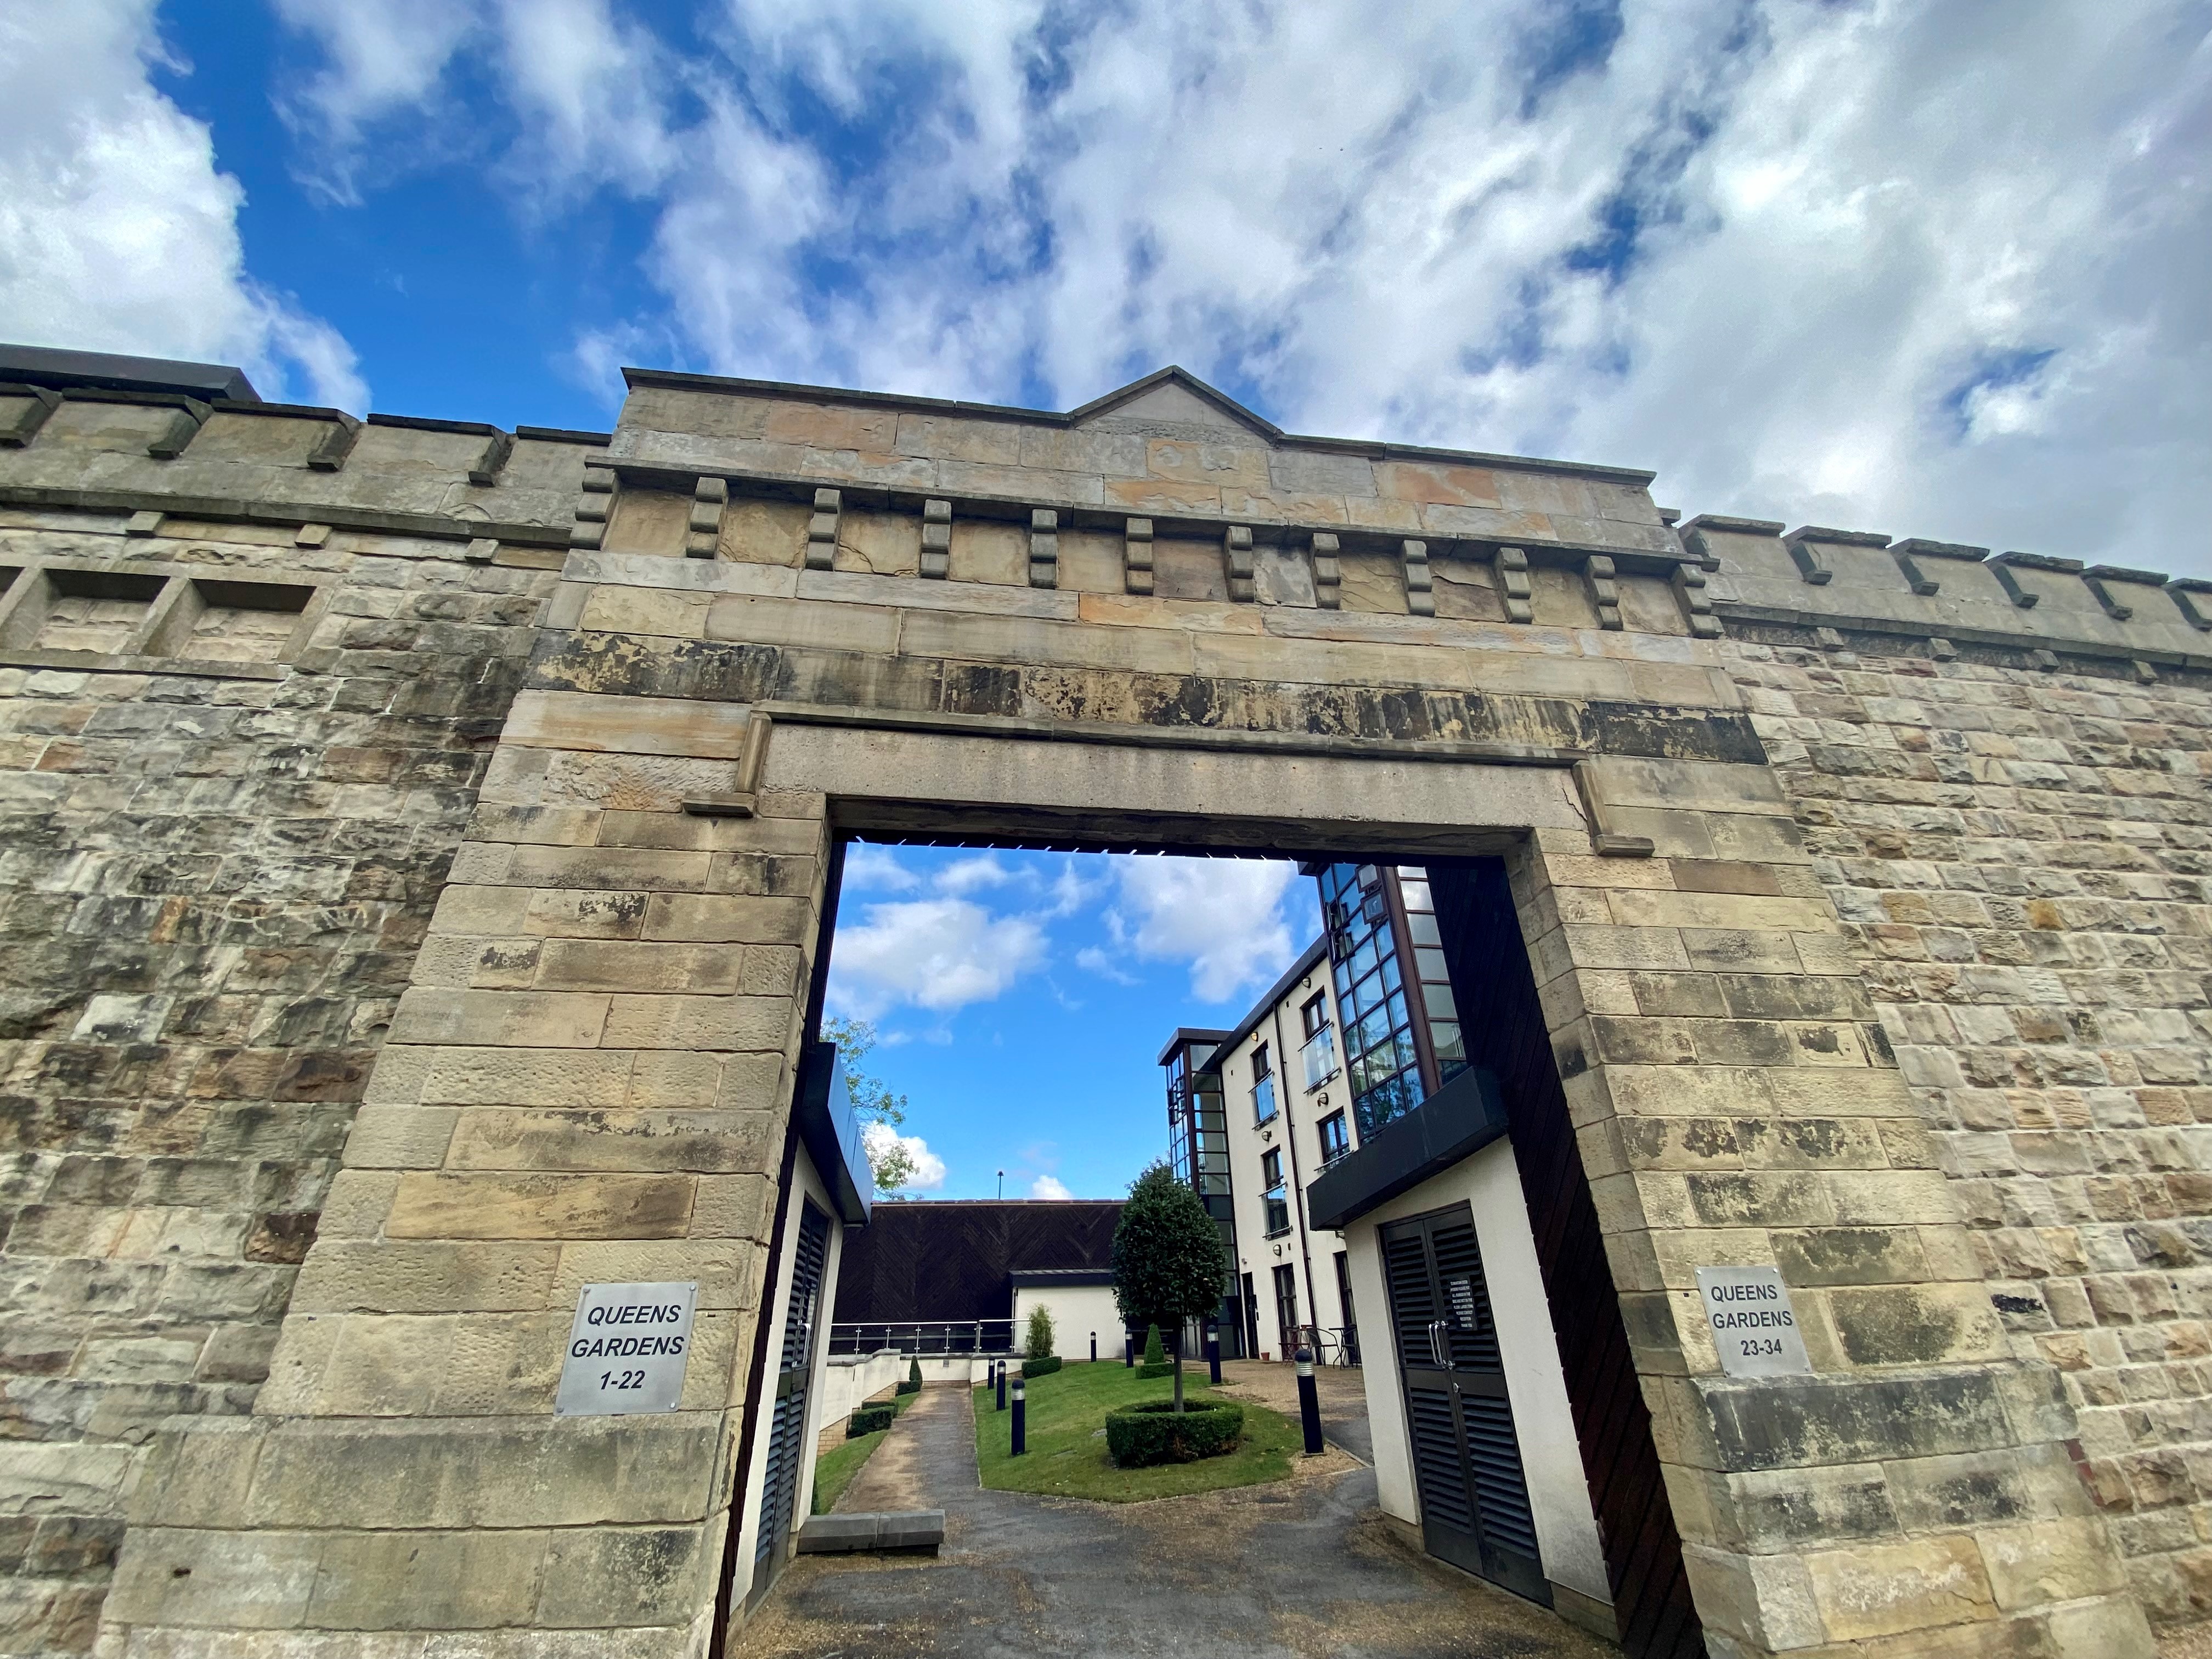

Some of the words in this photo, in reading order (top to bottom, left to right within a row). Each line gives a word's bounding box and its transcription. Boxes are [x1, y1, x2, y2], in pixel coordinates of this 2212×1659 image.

[1711, 1284, 1778, 1302] QUEENS
[588, 1305, 681, 1326] QUEENS
[1713, 1311, 1793, 1329] GARDENS
[572, 1336, 685, 1358] GARDENS
[1741, 1339, 1782, 1356] 23-34
[601, 1370, 645, 1390] 1-22
